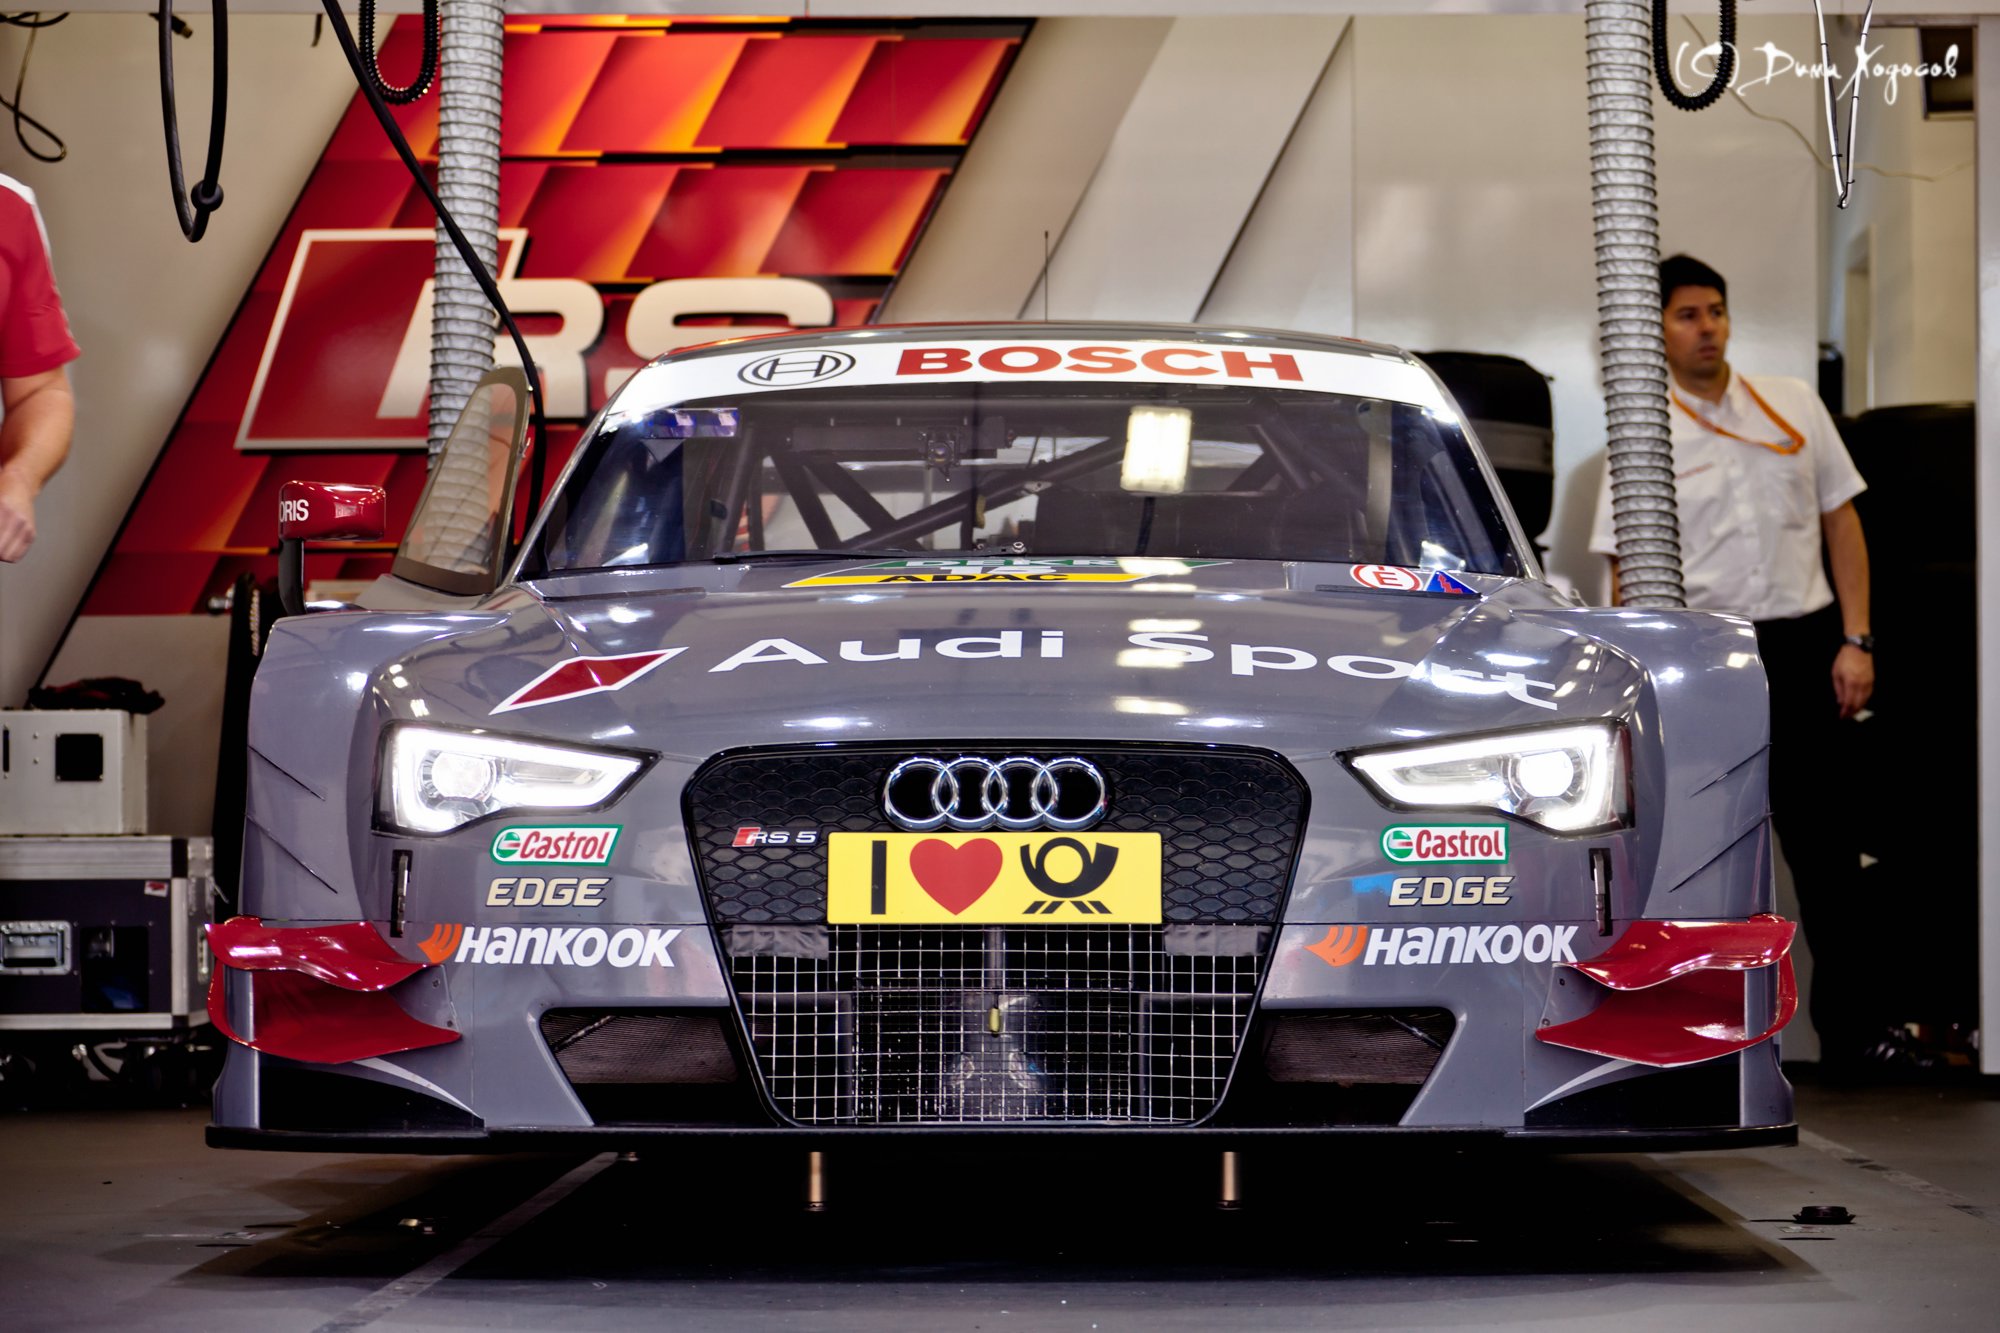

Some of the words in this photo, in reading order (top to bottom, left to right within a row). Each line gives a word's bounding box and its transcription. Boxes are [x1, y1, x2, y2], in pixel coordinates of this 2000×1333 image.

[895, 345, 1305, 383] BOSCH
[877, 574, 1068, 583] ADAC
[707, 630, 1064, 673] Audi
[1117, 632, 1558, 711] Sport
[519, 831, 610, 859] Castrol
[745, 831, 790, 845] RS
[795, 831, 817, 844] 5
[1415, 829, 1503, 859] Castrol
[485, 877, 612, 907] EDGE
[870, 839, 888, 915] I
[1388, 875, 1515, 907] EDGE
